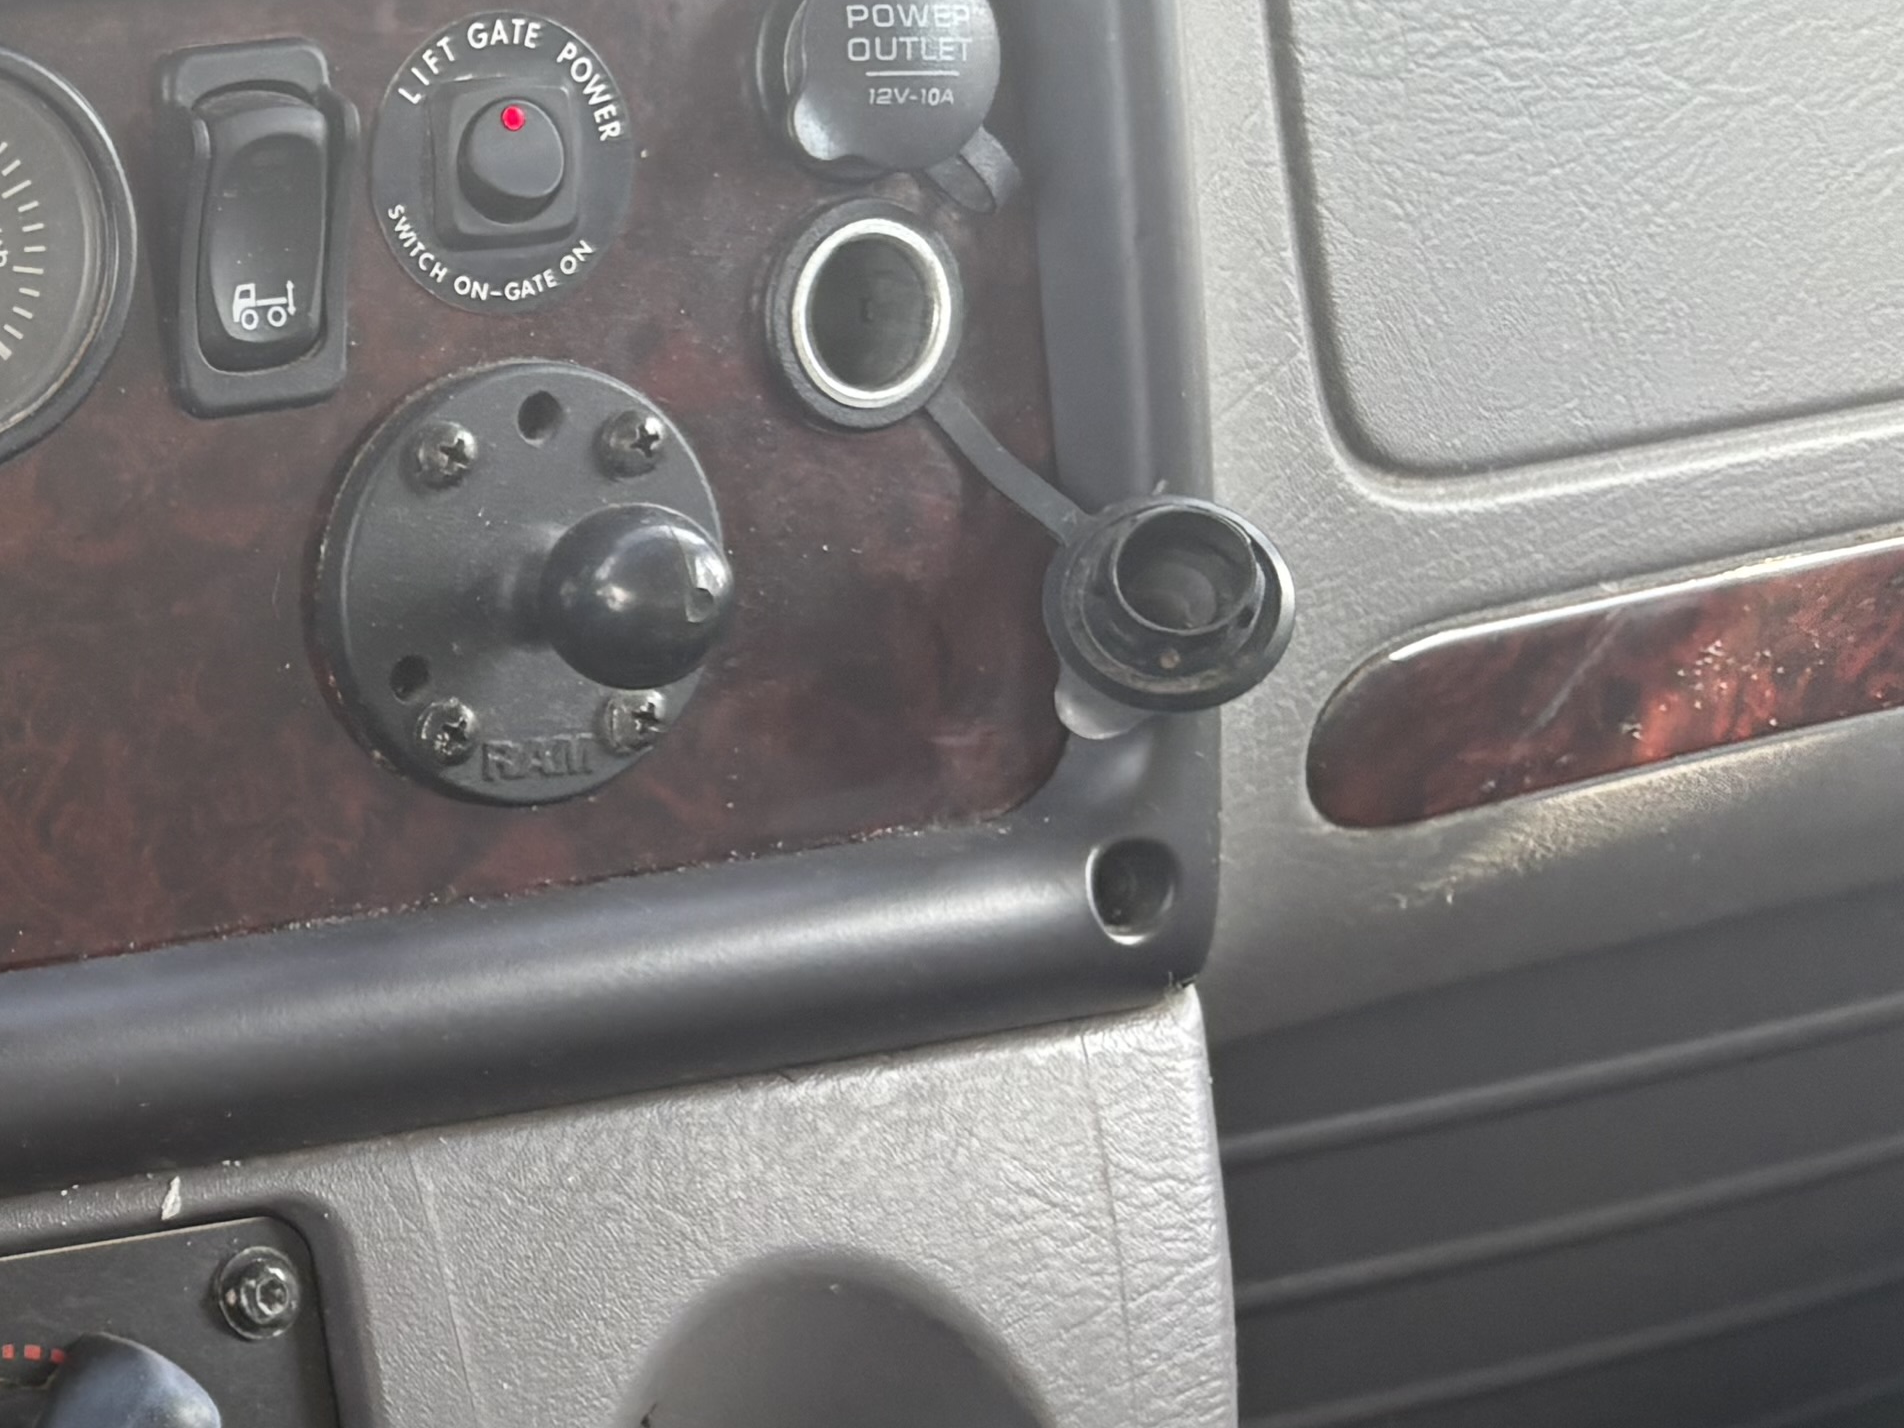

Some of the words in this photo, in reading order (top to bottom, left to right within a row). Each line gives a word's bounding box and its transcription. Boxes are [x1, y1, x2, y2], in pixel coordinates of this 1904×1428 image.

[846, 3, 970, 29] POWER
[847, 37, 973, 61] OUTLET
[398, 36, 456, 104] LIFT
[467, 18, 542, 49] GATE
[557, 42, 621, 141] POWER
[869, 88, 955, 106] 12V-10A
[388, 205, 448, 283] SWITCH
[559, 240, 594, 275] ON
